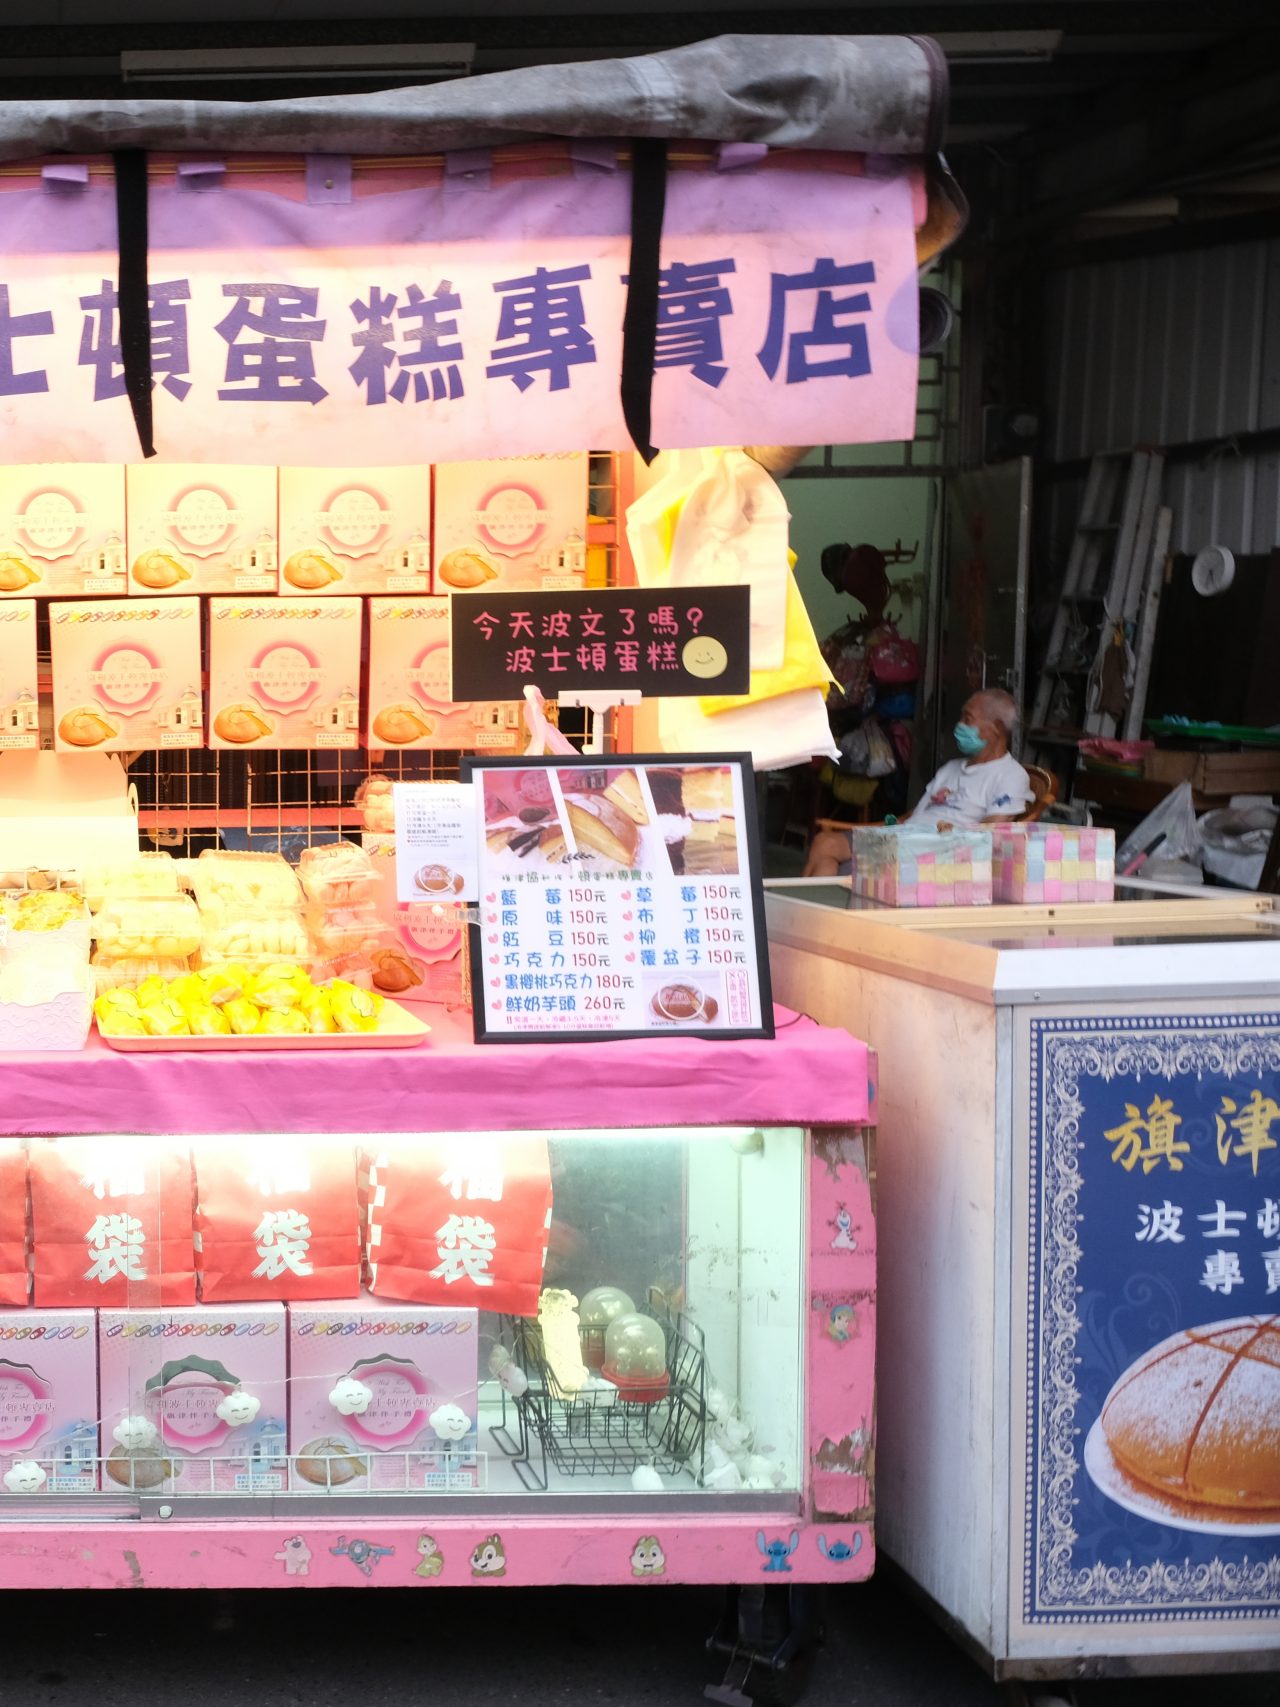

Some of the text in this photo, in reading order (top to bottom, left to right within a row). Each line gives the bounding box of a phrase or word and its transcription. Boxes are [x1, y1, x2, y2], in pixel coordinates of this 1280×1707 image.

[505, 640, 680, 673] 波士頓蛋糕
[570, 888, 607, 903] 150元
[703, 885, 742, 899] 150元
[502, 909, 608, 926] 原味 150元
[637, 906, 743, 923] 布丁 150元
[571, 931, 609, 945] 150元
[706, 928, 745, 942] 150元
[504, 952, 611, 968] 巧克力 150元
[707, 949, 747, 964] 150元
[596, 974, 635, 989] 180元
[506, 995, 626, 1012] 鮮奶芋頭 260元
[1103, 1089, 1280, 1178] 旗津
